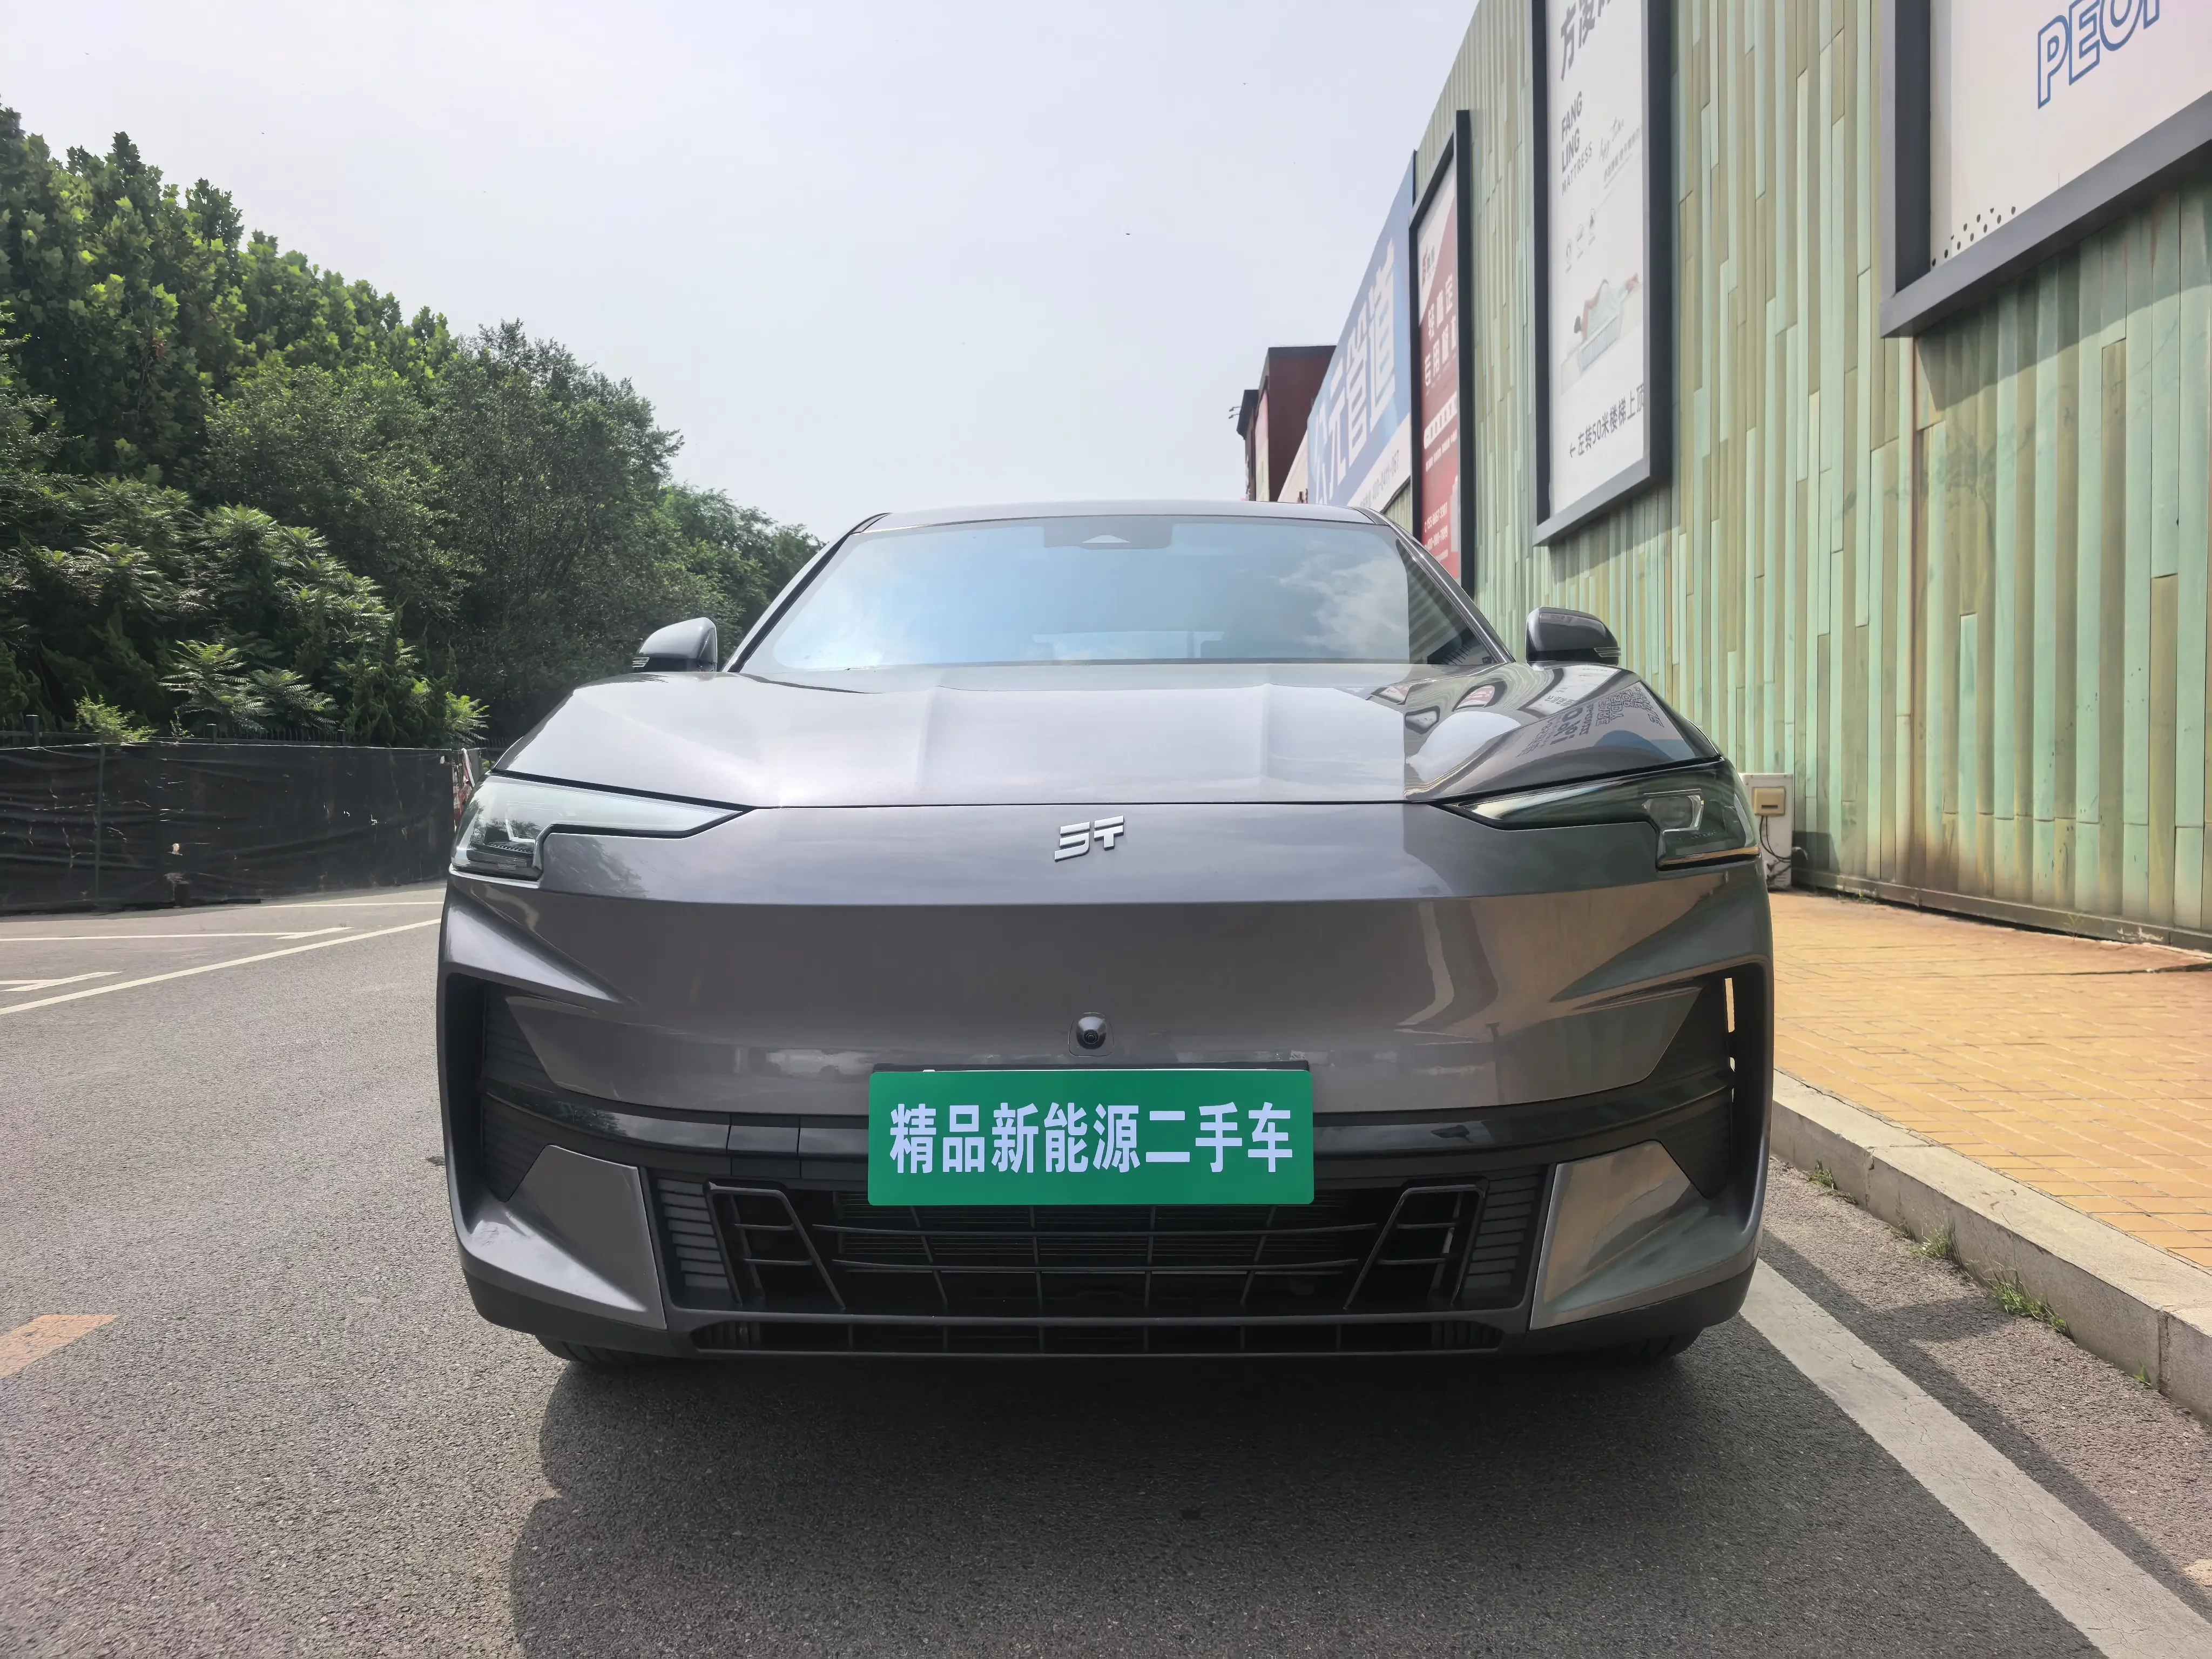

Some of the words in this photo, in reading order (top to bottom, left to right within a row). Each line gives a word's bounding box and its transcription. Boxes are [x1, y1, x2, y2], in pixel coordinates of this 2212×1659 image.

[1562, 91, 1582, 141] FANG
[1562, 127, 1580, 173] LING
[1562, 141, 1592, 196] MATTRESS
[889, 1101, 1293, 1174] 精品新能源二手车
